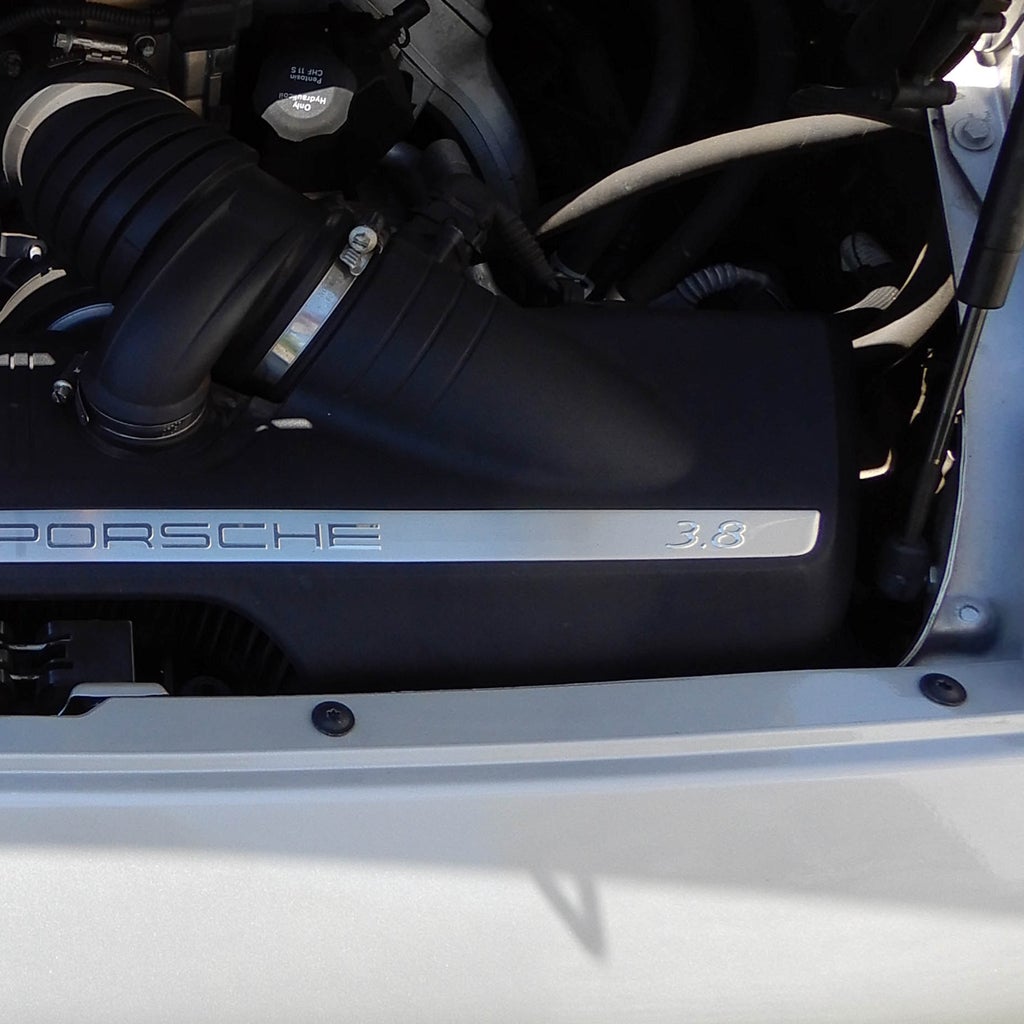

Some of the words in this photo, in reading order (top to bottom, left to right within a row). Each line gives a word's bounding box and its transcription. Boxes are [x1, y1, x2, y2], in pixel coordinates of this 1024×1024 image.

[307, 69, 324, 77] CHF
[290, 74, 322, 84] Pentosin
[292, 102, 312, 111] Only
[665, 520, 747, 549] 3.8
